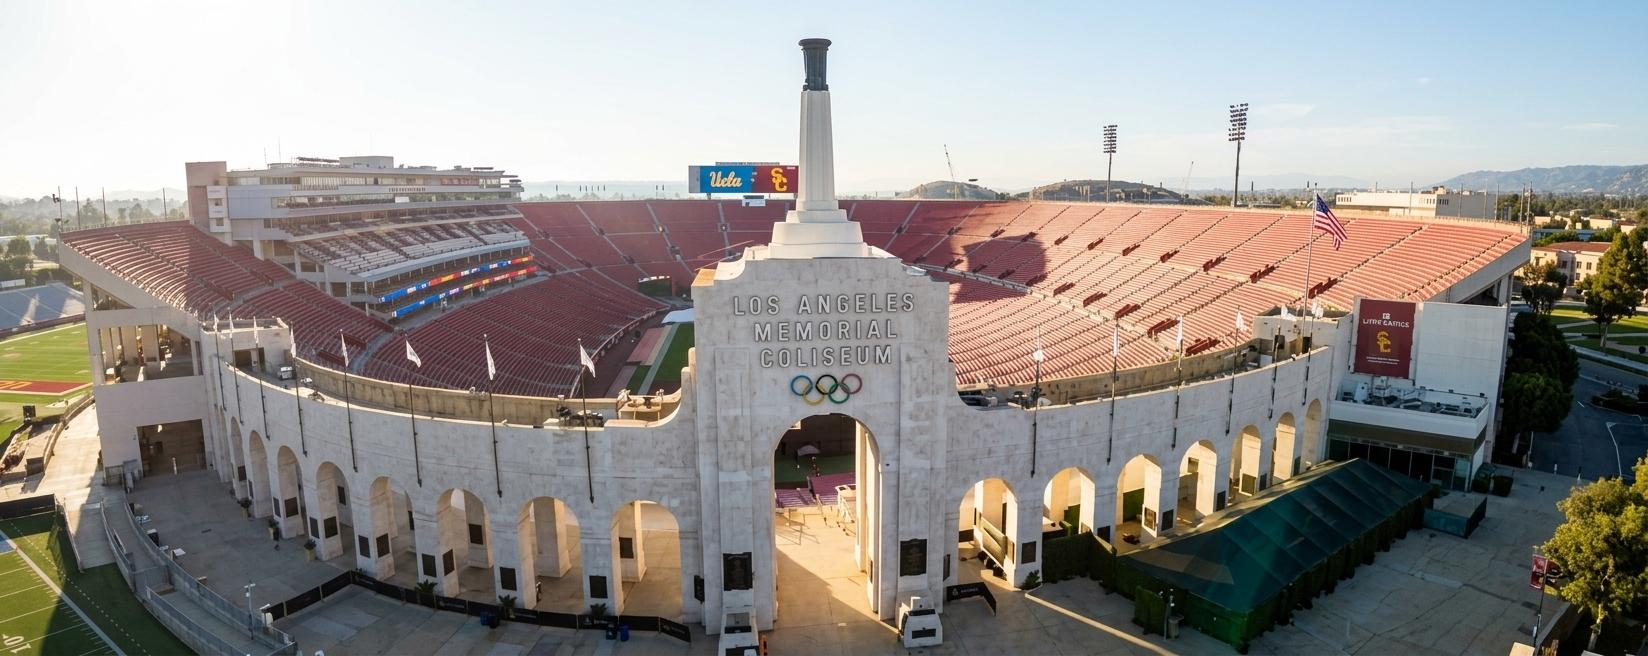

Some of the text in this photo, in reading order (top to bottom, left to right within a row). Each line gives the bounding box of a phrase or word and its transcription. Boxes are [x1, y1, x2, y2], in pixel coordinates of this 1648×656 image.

[733, 292, 915, 315] LOS ANGELES
[754, 319, 898, 342] MEMORIAL
[760, 345, 892, 369] COLISEUM
